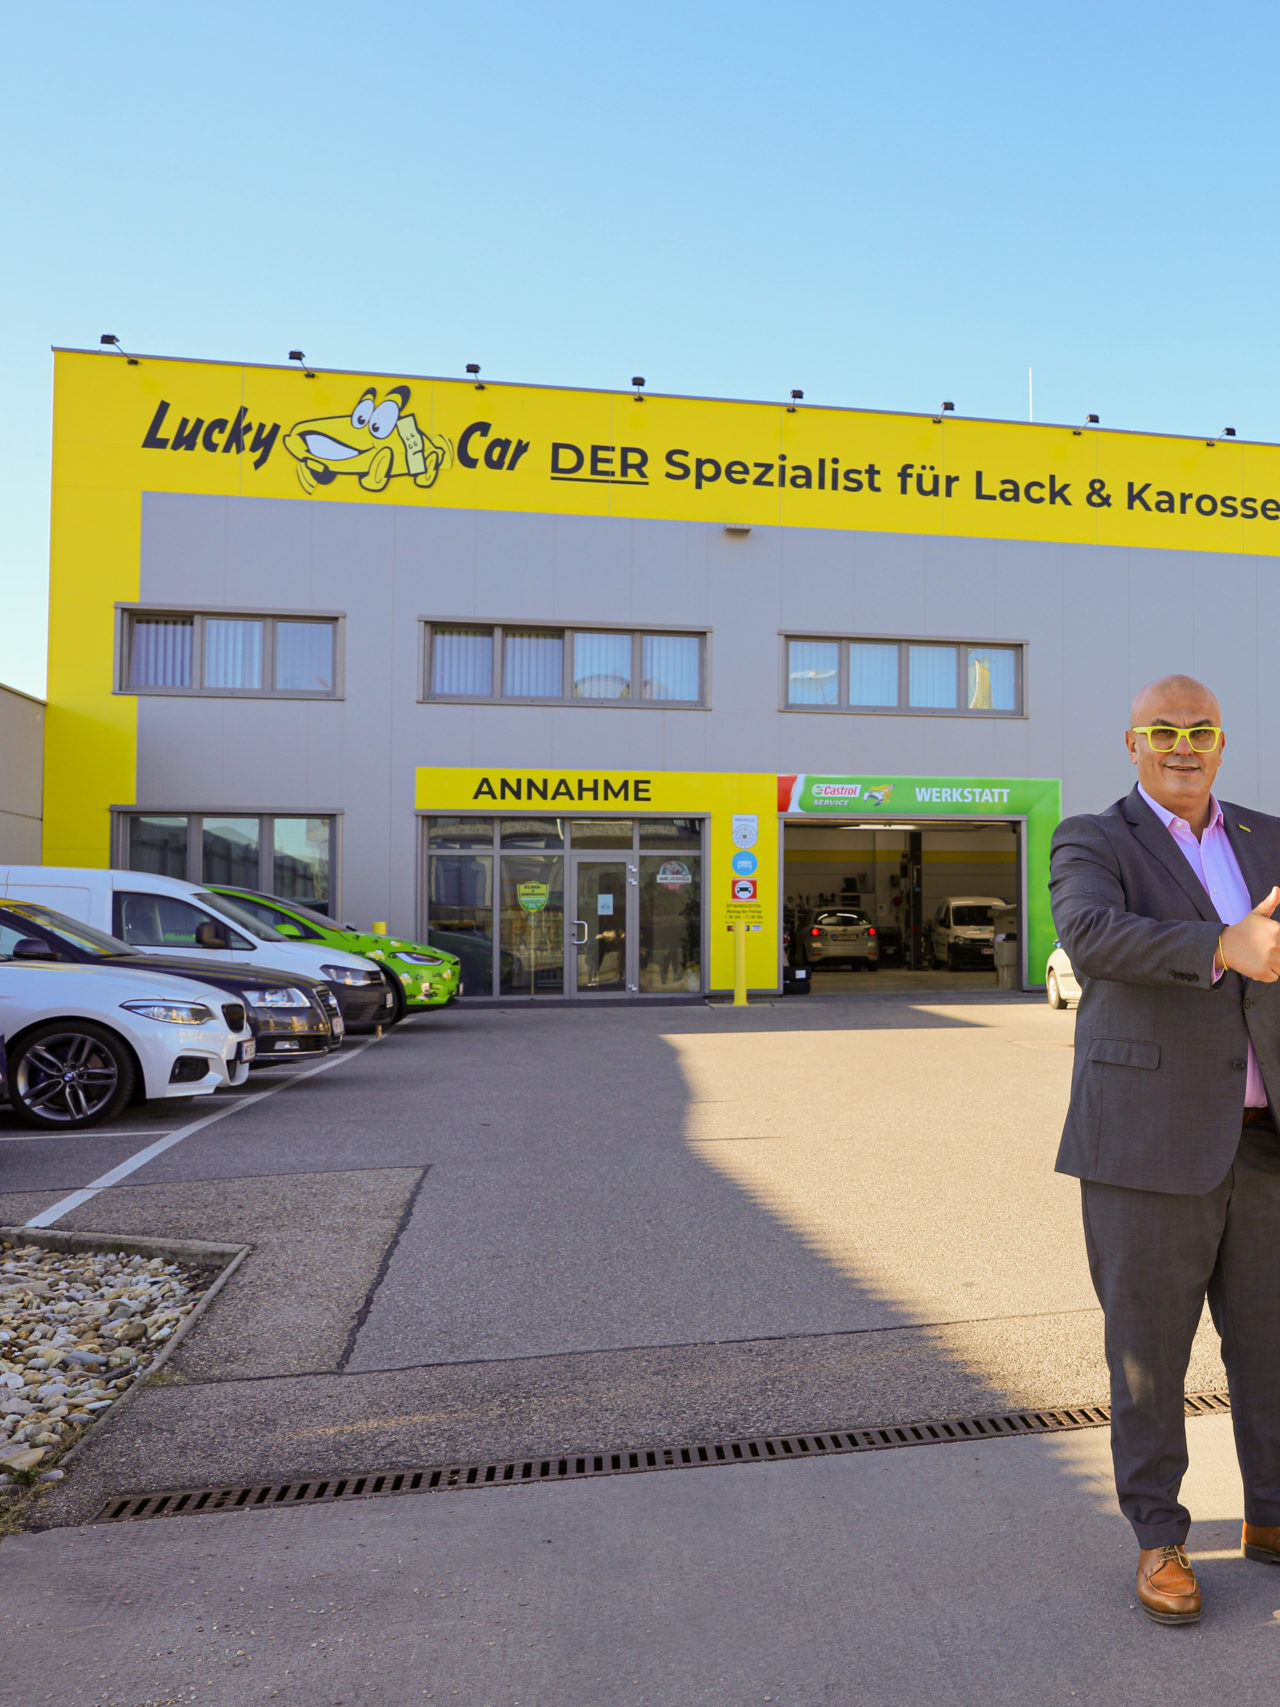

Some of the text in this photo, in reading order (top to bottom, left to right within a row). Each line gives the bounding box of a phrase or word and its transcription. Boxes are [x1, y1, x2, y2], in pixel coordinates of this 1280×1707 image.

[141, 399, 531, 471] Lucky Car
[550, 442, 650, 478] DER
[664, 448, 882, 494] Spezialist
[897, 463, 960, 498] für
[975, 470, 1073, 506] Lack
[1085, 478, 1113, 508] &
[472, 777, 652, 802] ANNAHME
[823, 785, 858, 796] Castrol
[915, 787, 1011, 803] WERKSTATT
